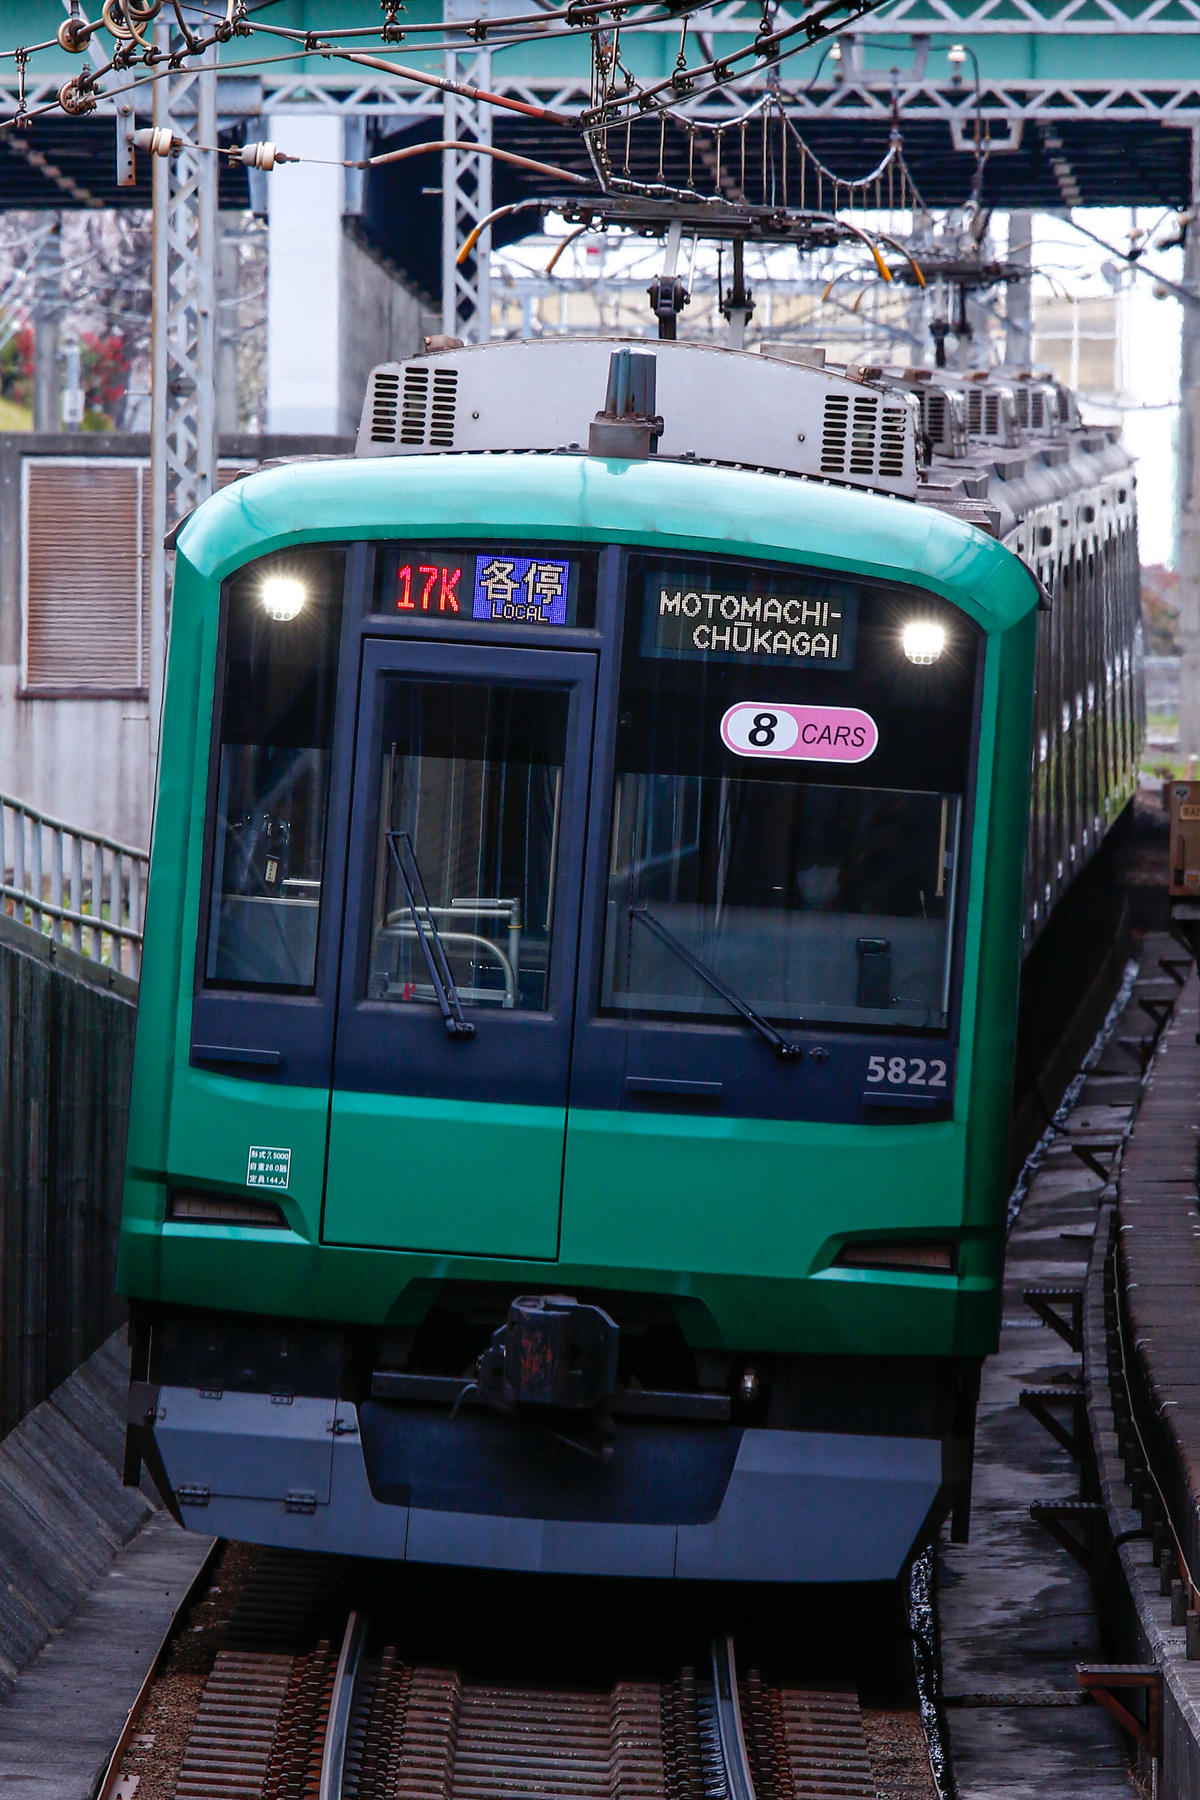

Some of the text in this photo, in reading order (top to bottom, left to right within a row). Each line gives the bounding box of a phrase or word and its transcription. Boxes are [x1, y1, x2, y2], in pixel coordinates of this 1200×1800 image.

[397, 565, 462, 612] 17K
[479, 560, 563, 604] 各停
[492, 603, 548, 622] LOCAL
[659, 590, 842, 627] MOTOMACHI-
[748, 713, 866, 747] 8 CARS
[866, 1055, 947, 1087] 5822
